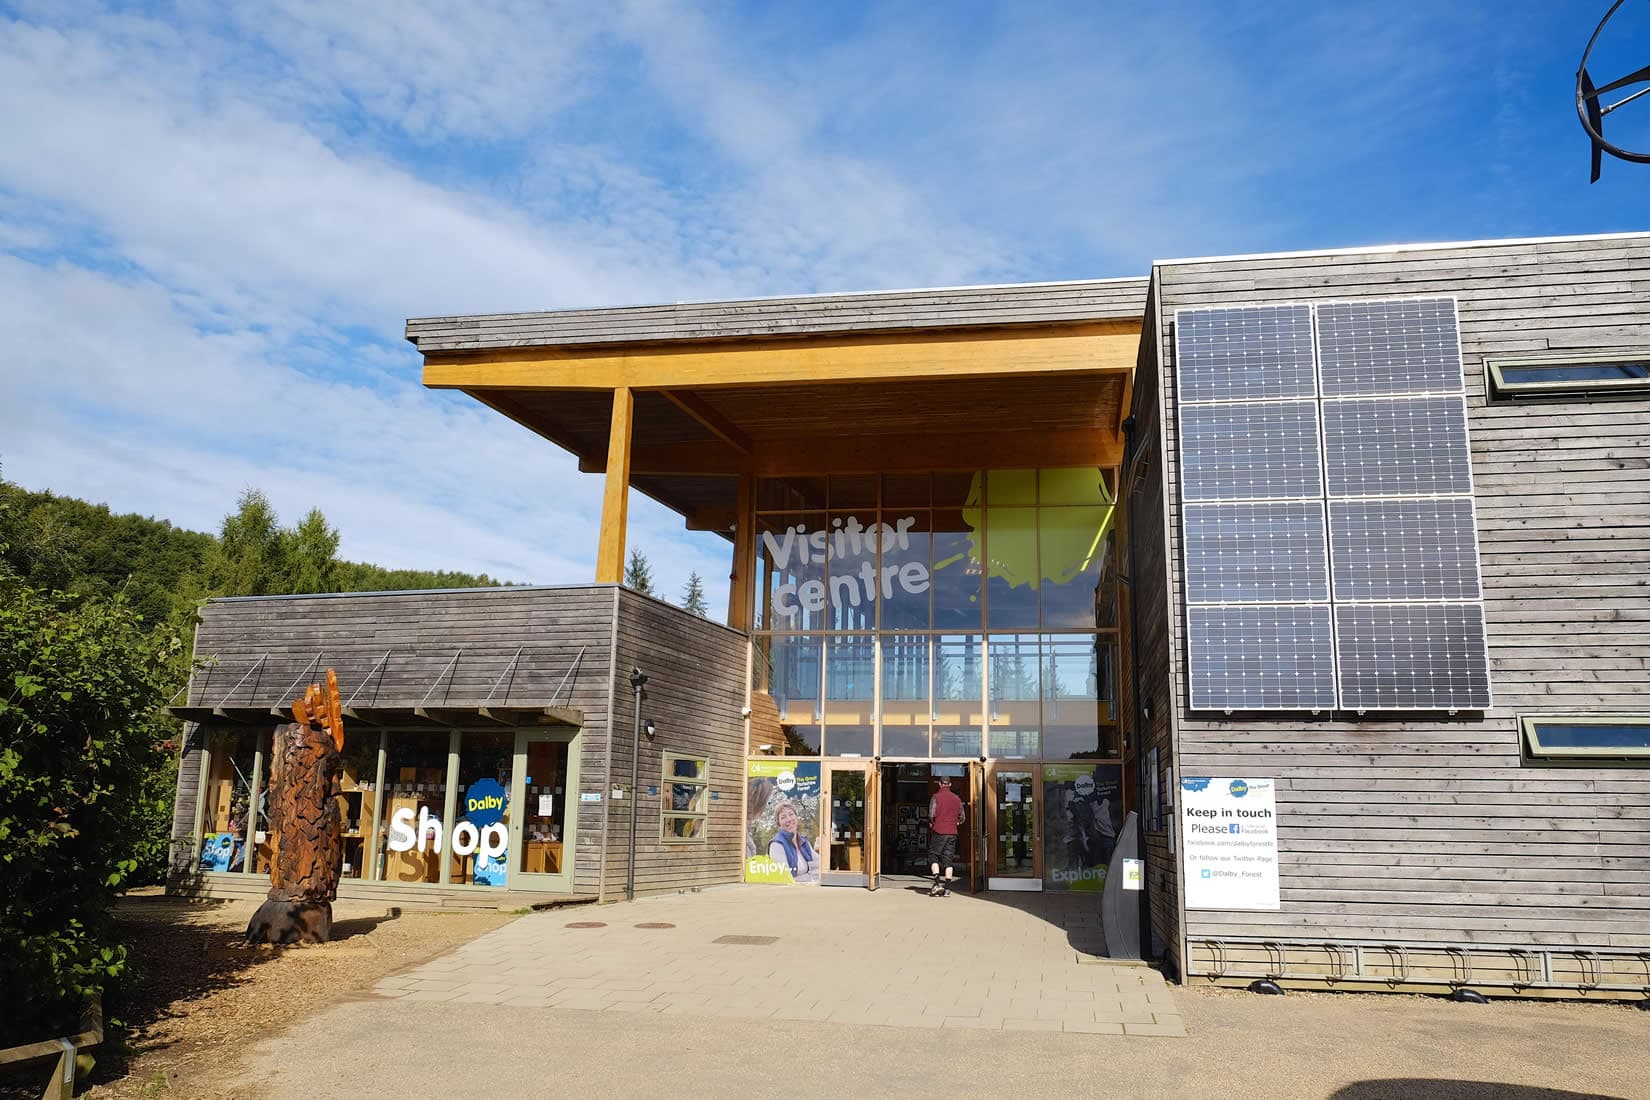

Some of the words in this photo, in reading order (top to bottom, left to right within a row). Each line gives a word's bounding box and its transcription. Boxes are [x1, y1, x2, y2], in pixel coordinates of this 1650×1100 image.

[762, 515, 917, 570] Visitor
[771, 560, 931, 618] centre
[468, 795, 504, 812] Dalby
[1186, 807, 1217, 819] Keep
[1221, 807, 1232, 817] in
[1237, 808, 1272, 818] touch
[389, 805, 509, 870] Shop
[1191, 823, 1228, 834] Please
